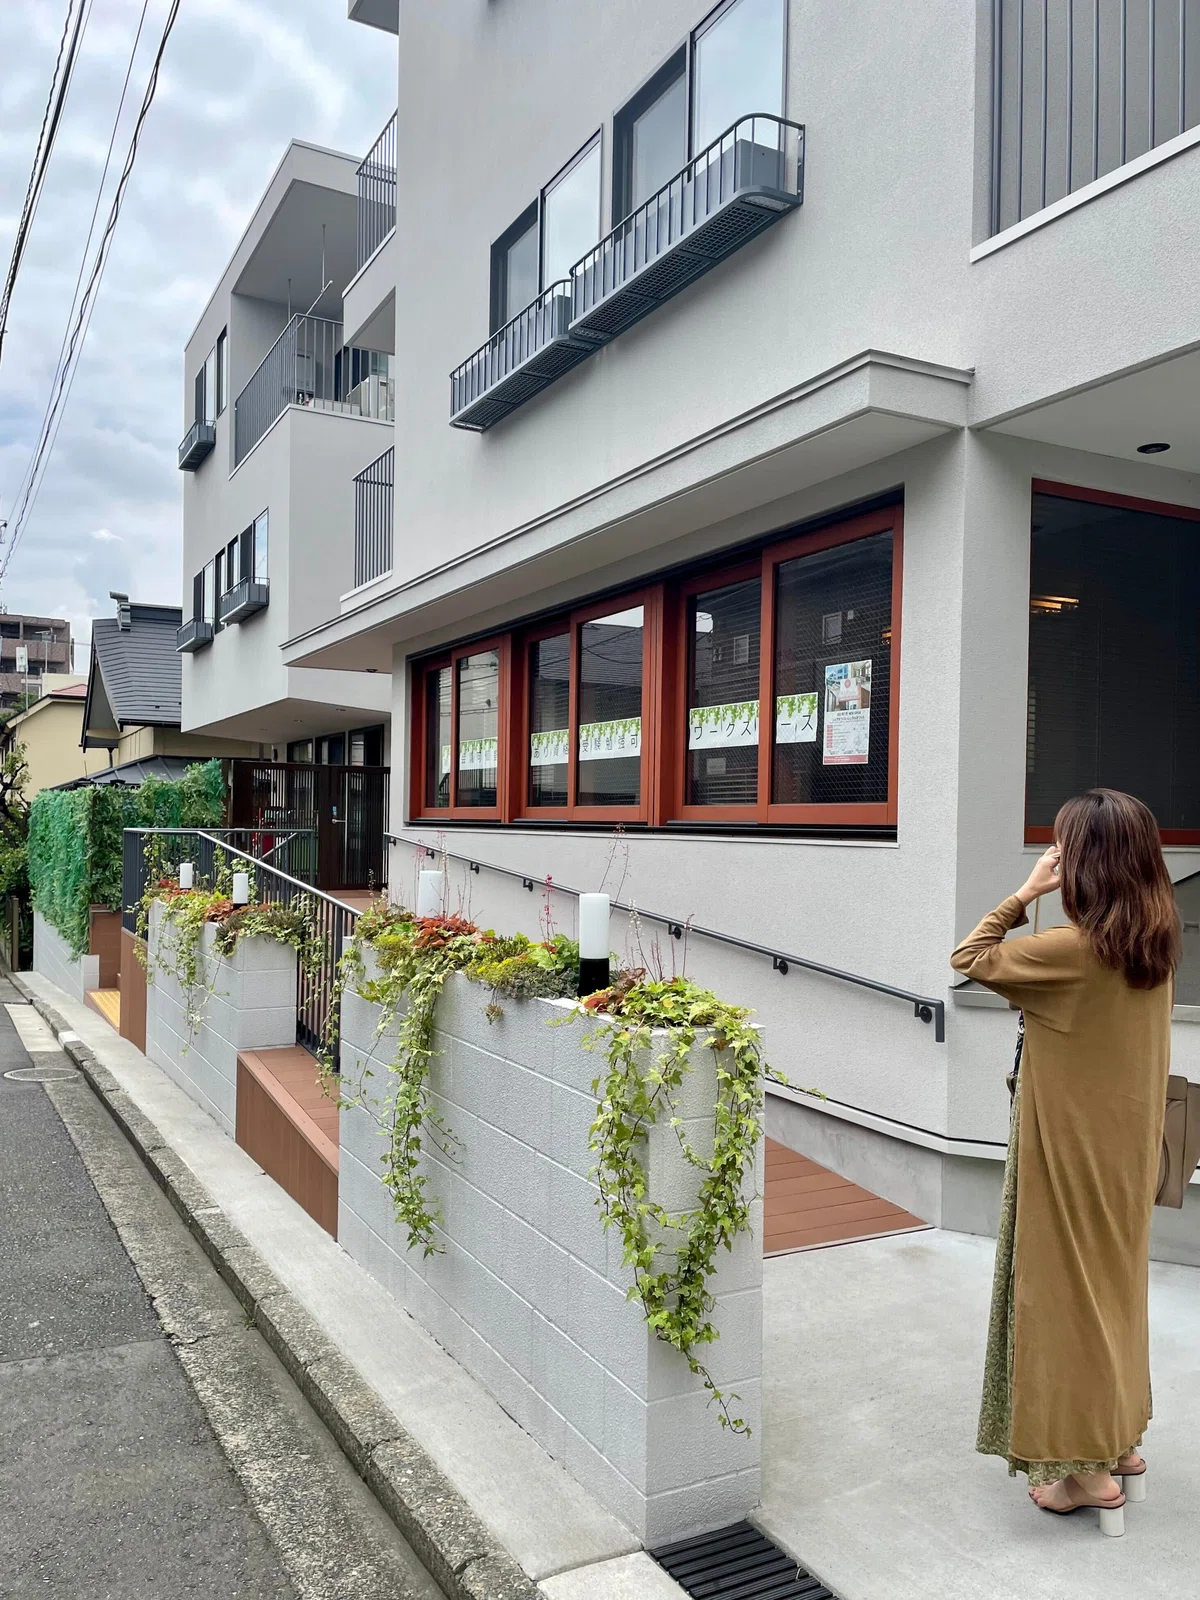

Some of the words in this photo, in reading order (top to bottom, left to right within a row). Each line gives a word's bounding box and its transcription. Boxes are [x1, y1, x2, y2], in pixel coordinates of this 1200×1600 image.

[694, 714, 814, 741] ワークスース
